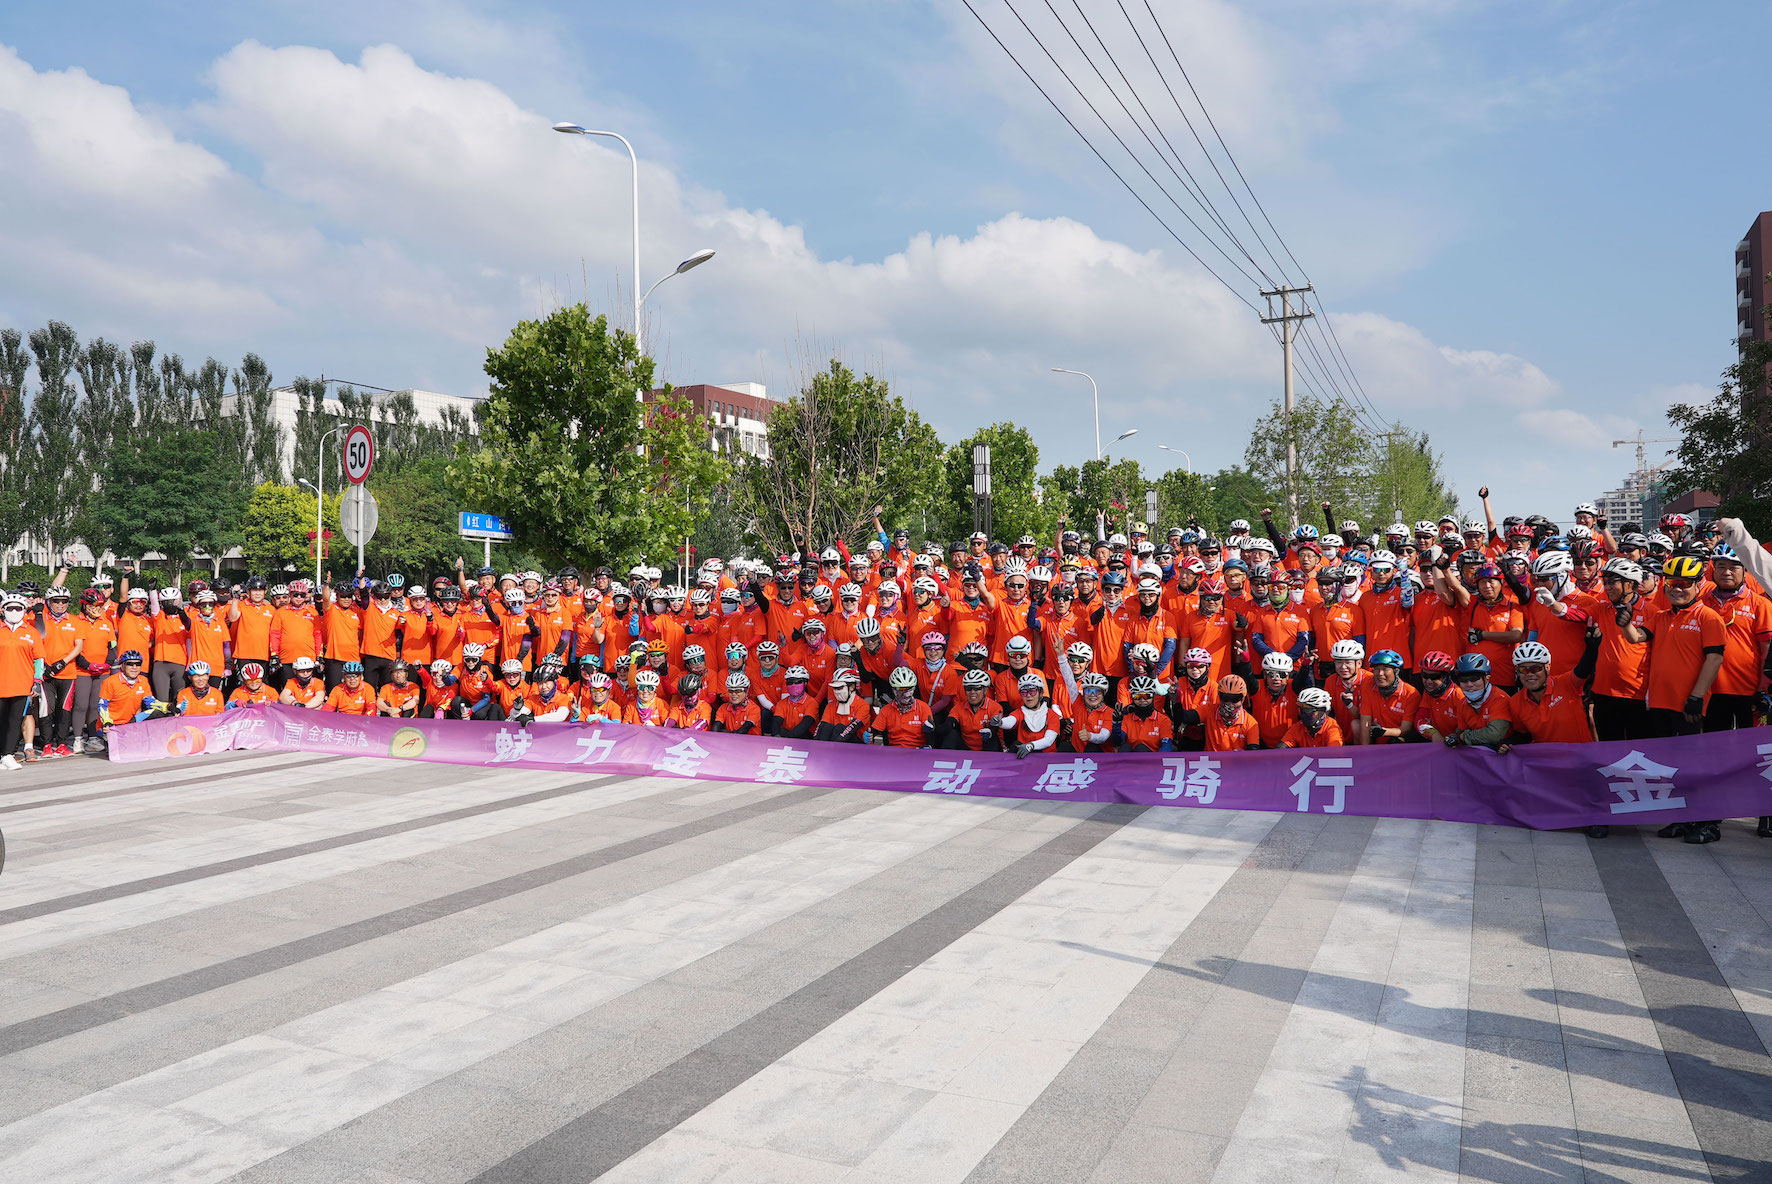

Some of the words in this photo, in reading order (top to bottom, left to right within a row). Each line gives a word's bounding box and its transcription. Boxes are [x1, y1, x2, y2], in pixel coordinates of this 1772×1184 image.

[350, 441, 367, 470] 50
[484, 727, 810, 784] 魅力金泰
[922, 755, 1356, 814] 动感骑行
[1596, 743, 1772, 815] 金
